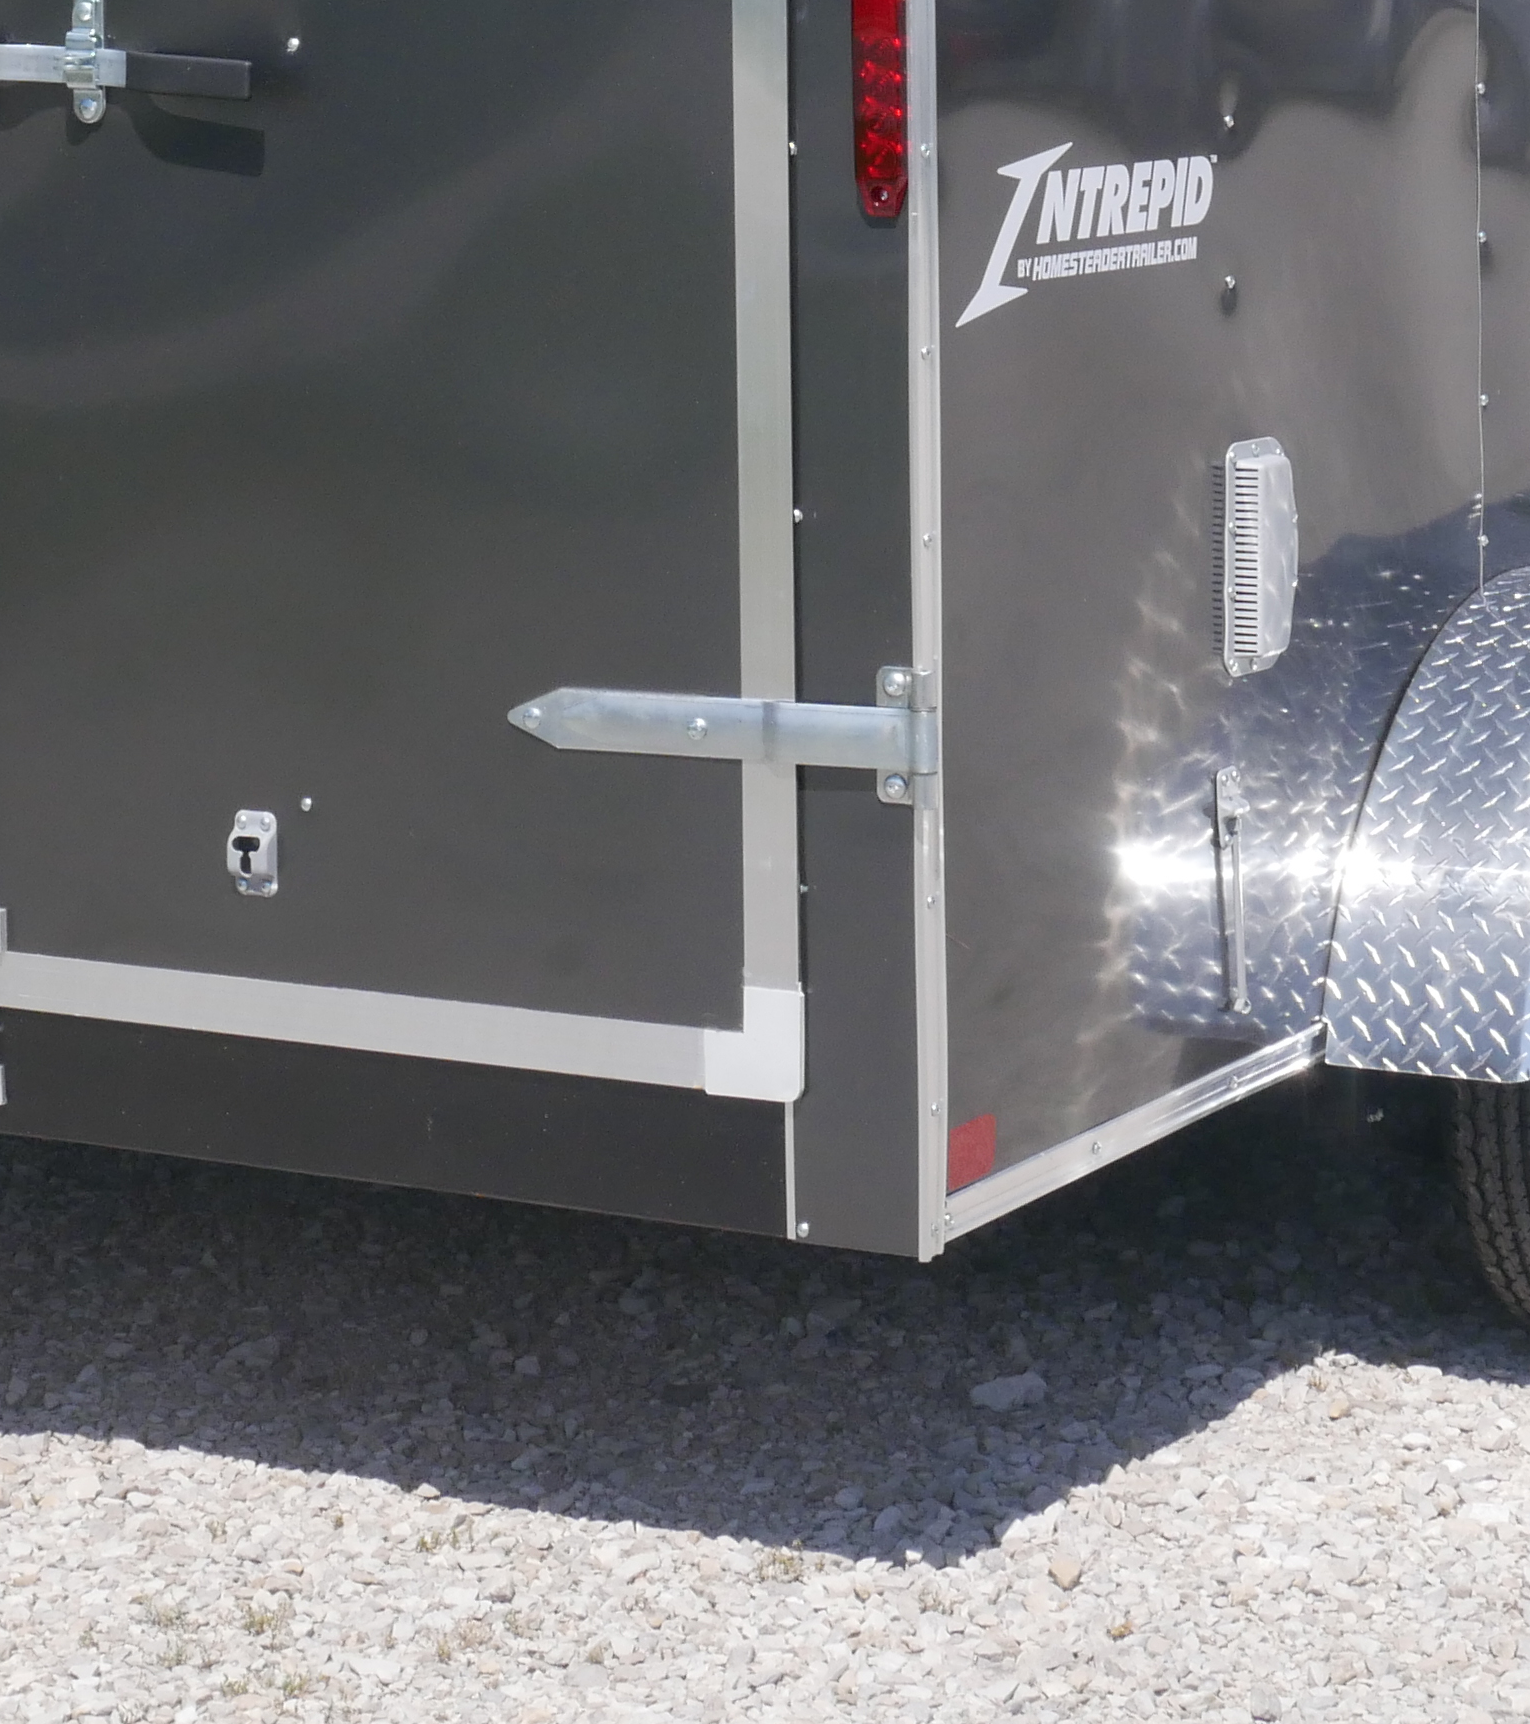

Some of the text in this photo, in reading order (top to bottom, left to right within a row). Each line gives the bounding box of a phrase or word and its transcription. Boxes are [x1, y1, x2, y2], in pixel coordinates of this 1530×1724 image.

[955, 142, 1214, 328] INTREPID
[1017, 236, 1198, 281] BY HOMESTEADERTRAILER.COM
